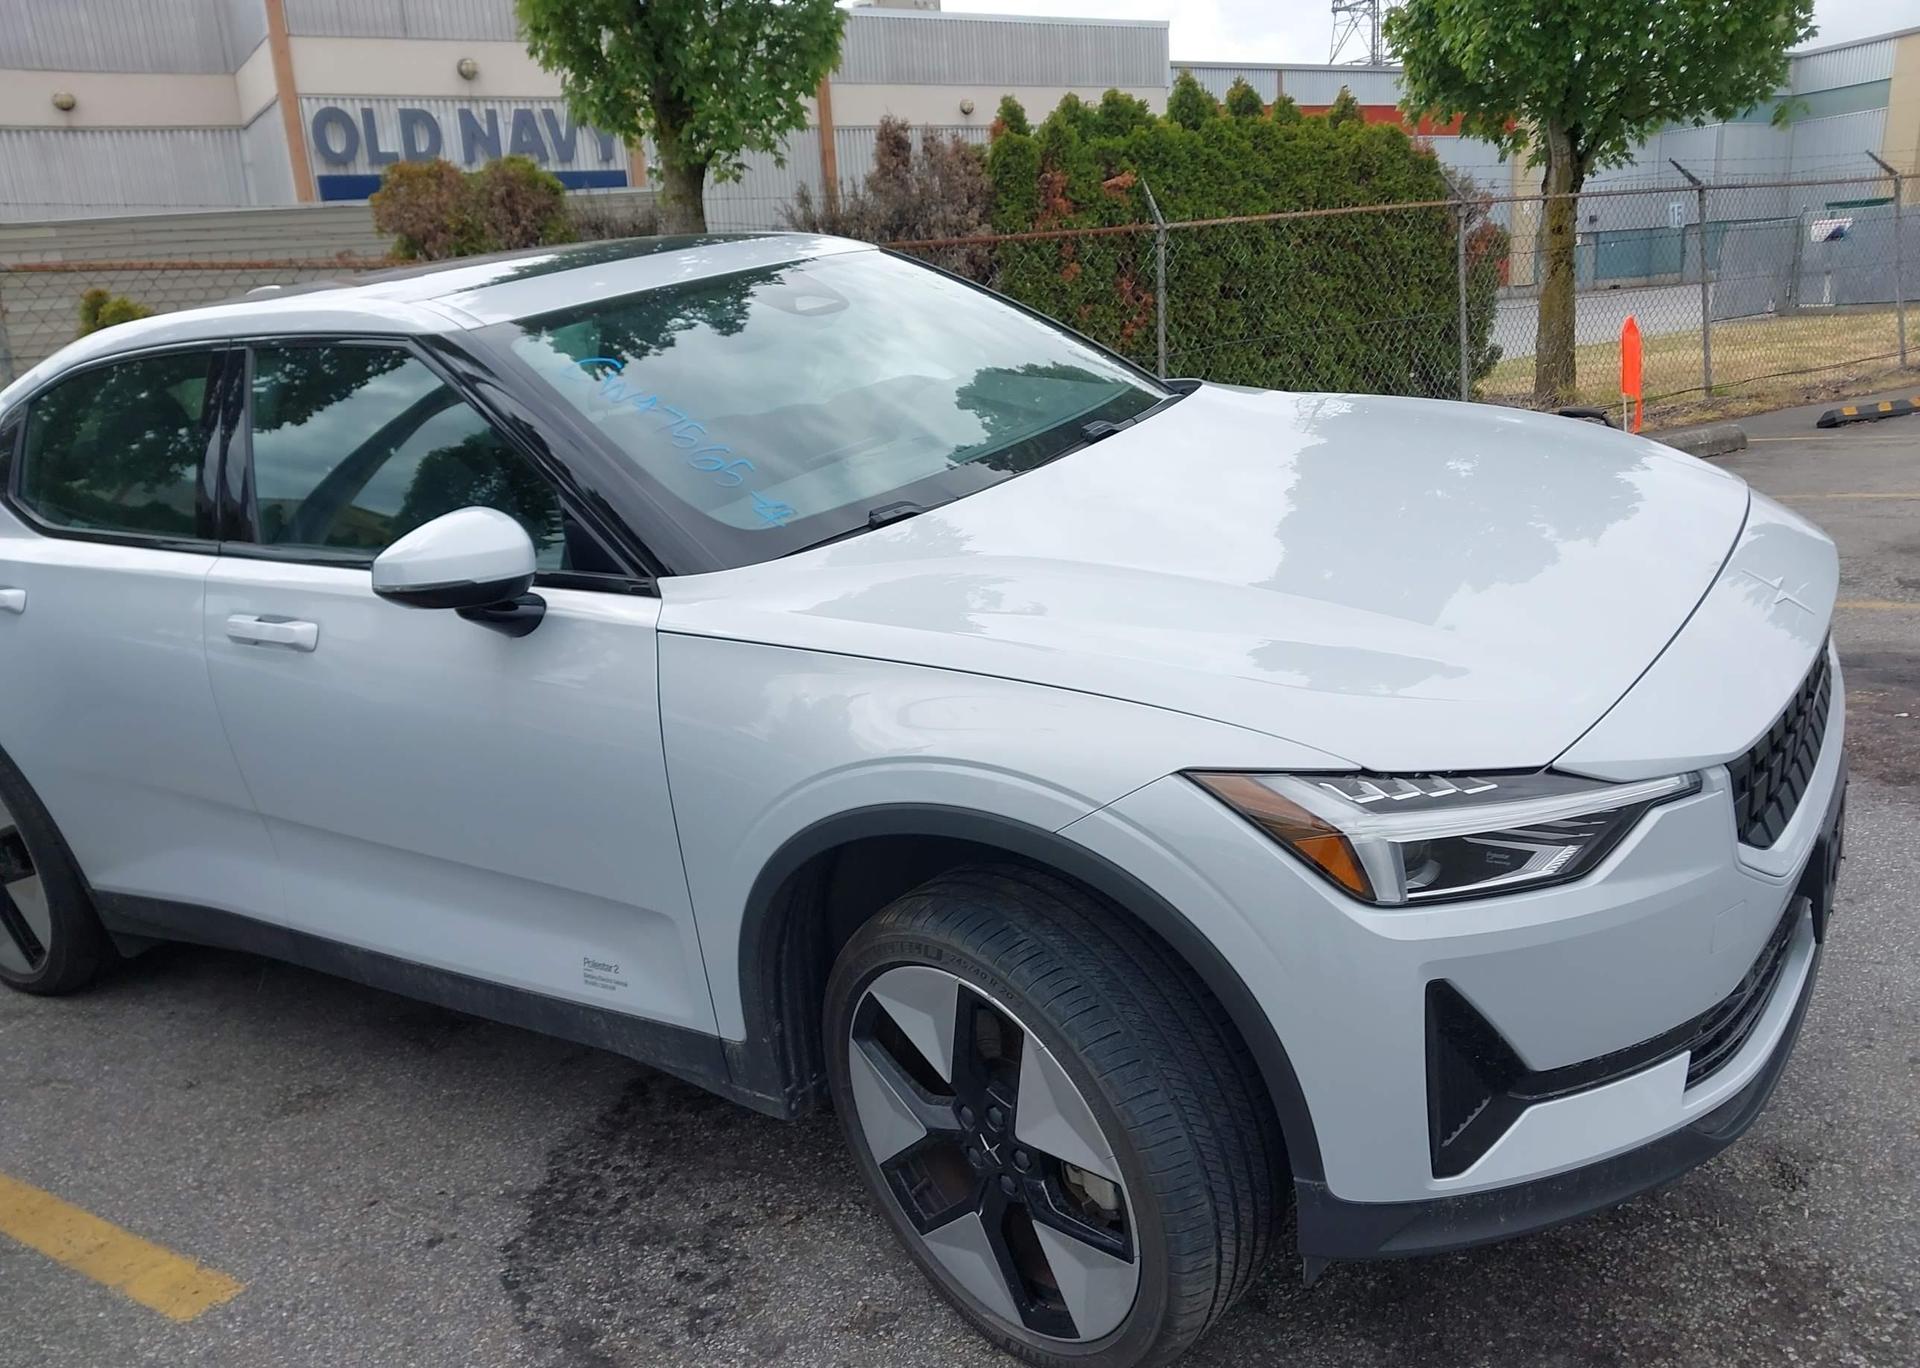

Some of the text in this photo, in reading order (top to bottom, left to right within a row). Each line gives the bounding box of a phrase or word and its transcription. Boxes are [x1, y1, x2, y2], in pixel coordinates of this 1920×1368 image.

[312, 106, 616, 165] OLD NAVY
[1671, 205, 1683, 226] 15
[614, 964, 620, 975] 2
